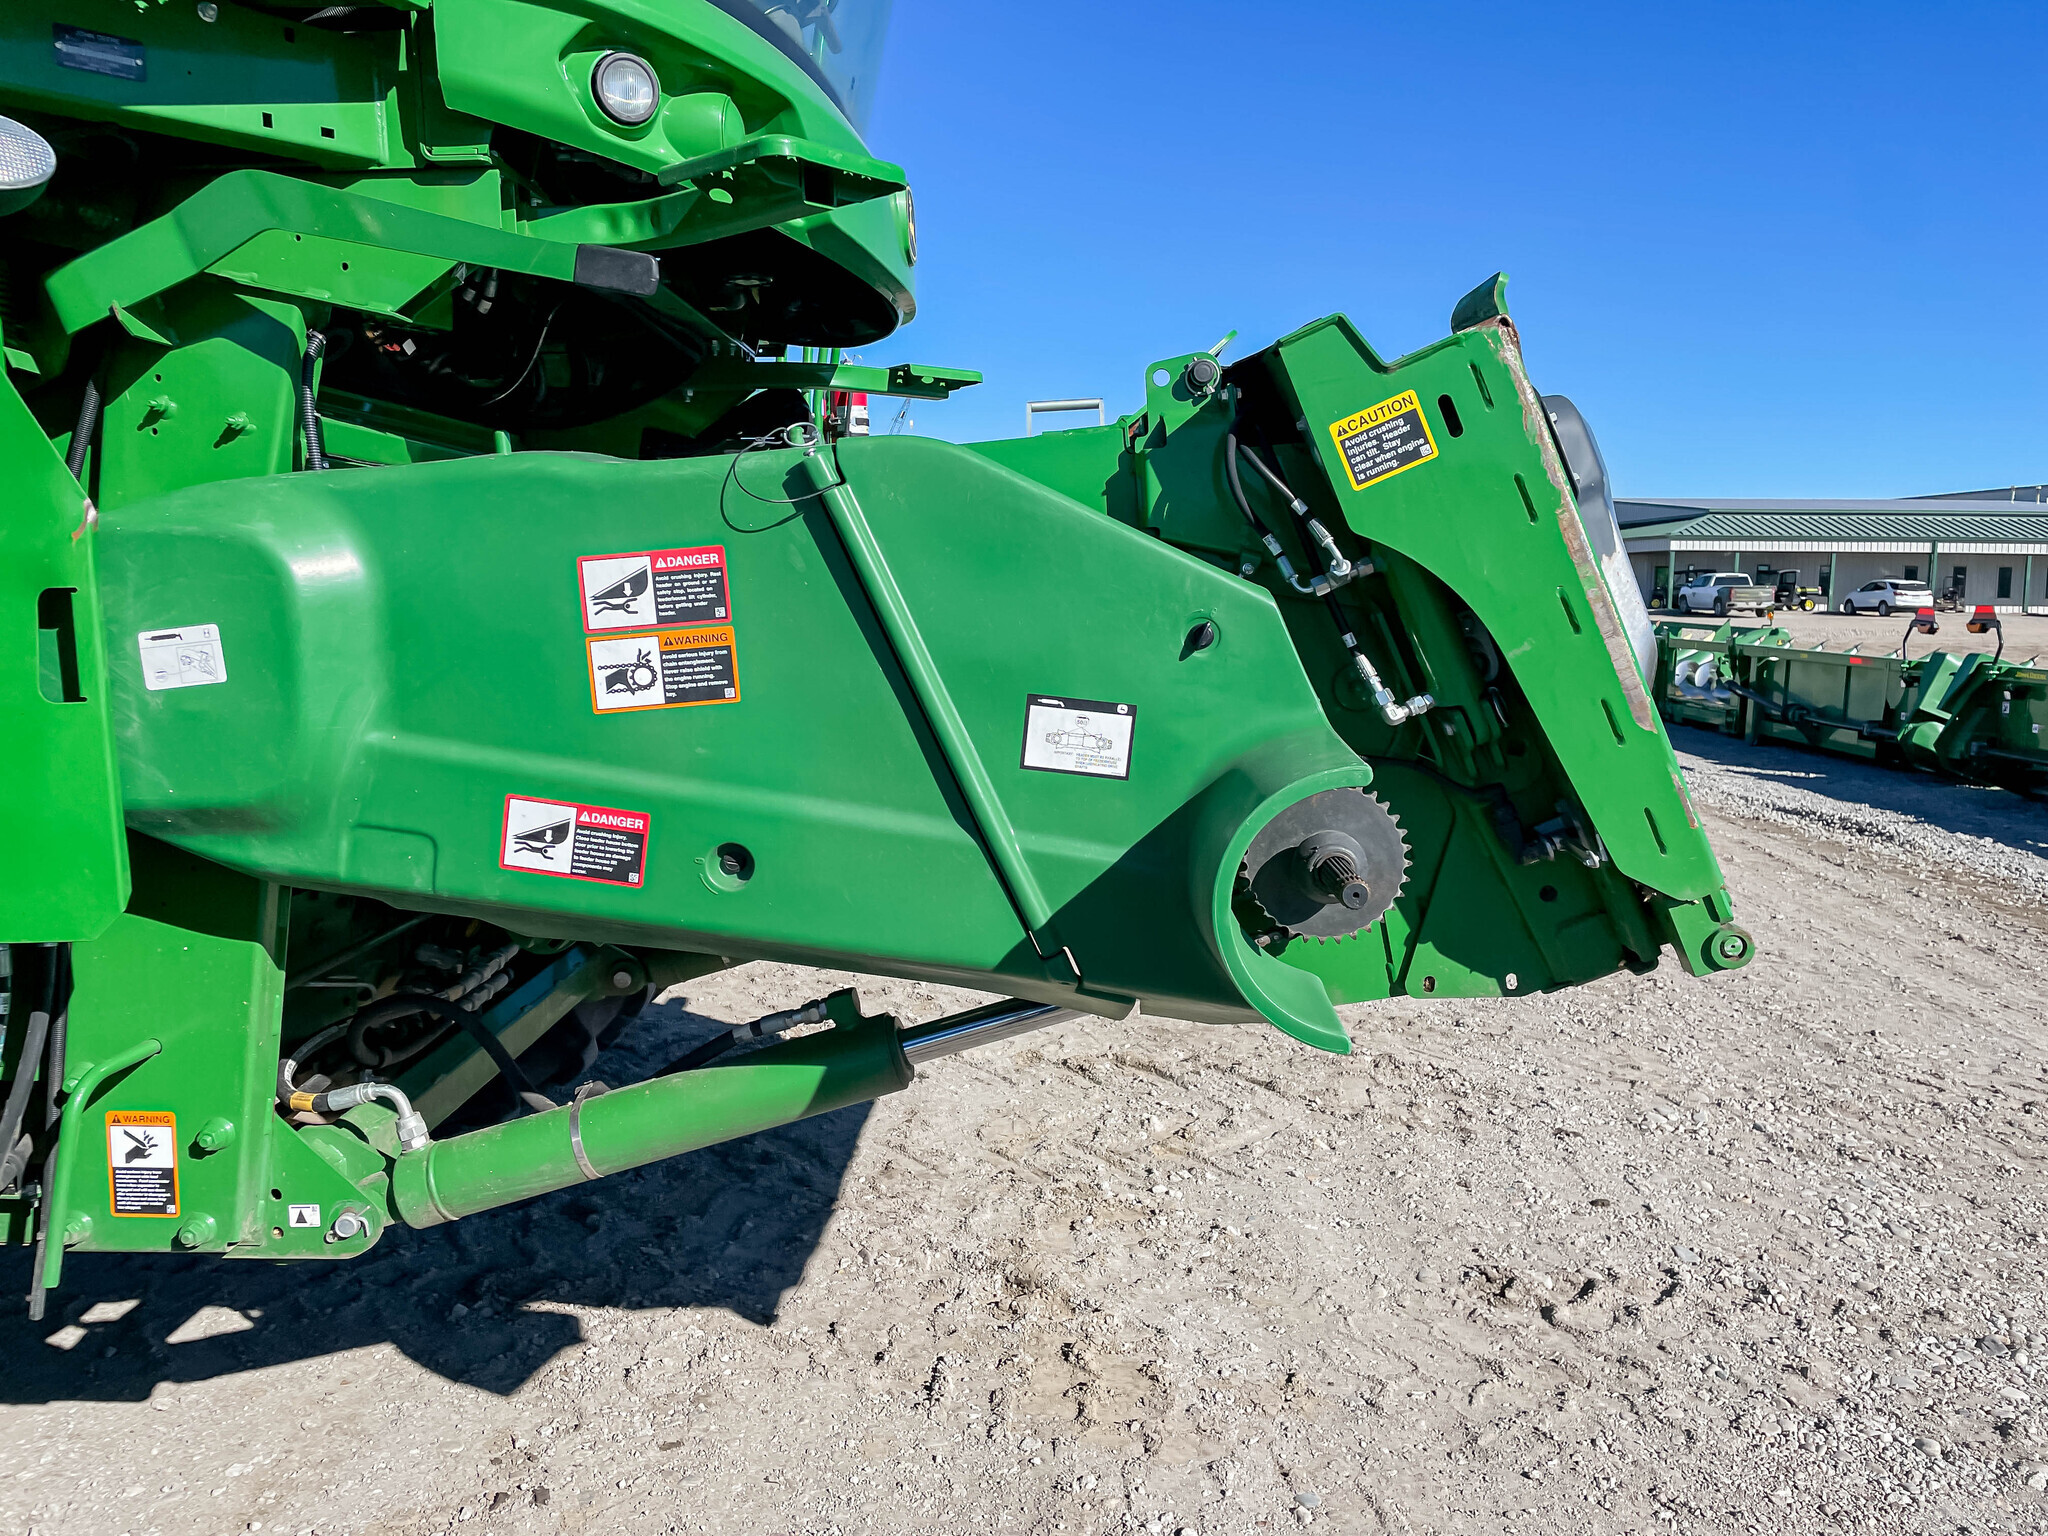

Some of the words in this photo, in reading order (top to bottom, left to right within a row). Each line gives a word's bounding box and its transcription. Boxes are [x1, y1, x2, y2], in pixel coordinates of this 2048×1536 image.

[1347, 395, 1413, 431] CAUTION
[1345, 433, 1367, 448] Avoid
[1369, 418, 1404, 437] crushing
[1382, 424, 1411, 441] Header
[1351, 455, 1366, 464] can
[1366, 448, 1380, 457] tilt.
[1382, 438, 1401, 450] Stay
[1354, 459, 1373, 472] clear
[1376, 450, 1396, 463] when
[1397, 438, 1424, 454] engine
[1366, 459, 1399, 477] running.
[667, 554, 719, 567] DANGER
[674, 633, 728, 645] WARNING
[592, 813, 643, 829] DANGER
[123, 1115, 170, 1123] WARNING
